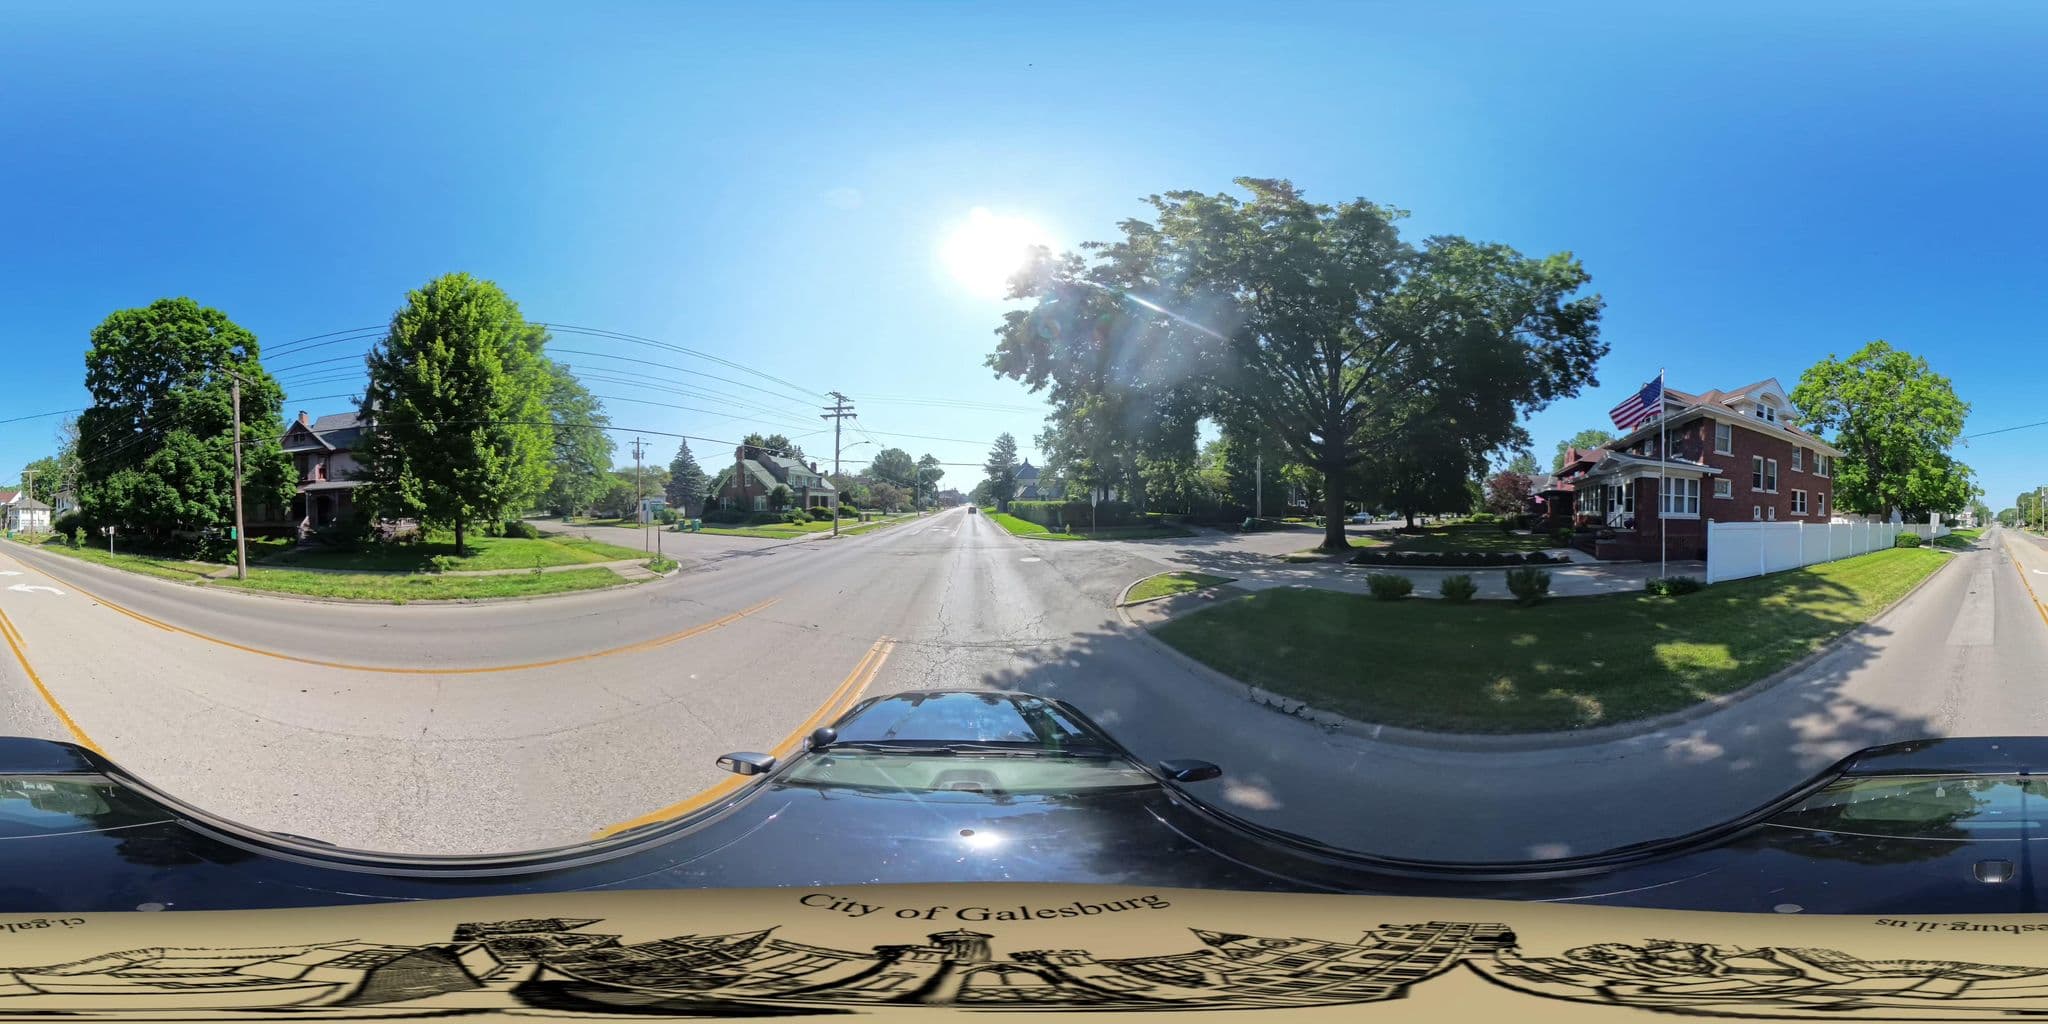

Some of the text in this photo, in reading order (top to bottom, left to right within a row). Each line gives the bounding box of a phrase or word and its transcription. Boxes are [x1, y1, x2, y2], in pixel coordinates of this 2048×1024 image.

[799, 893, 1172, 921] City of Galesburg
